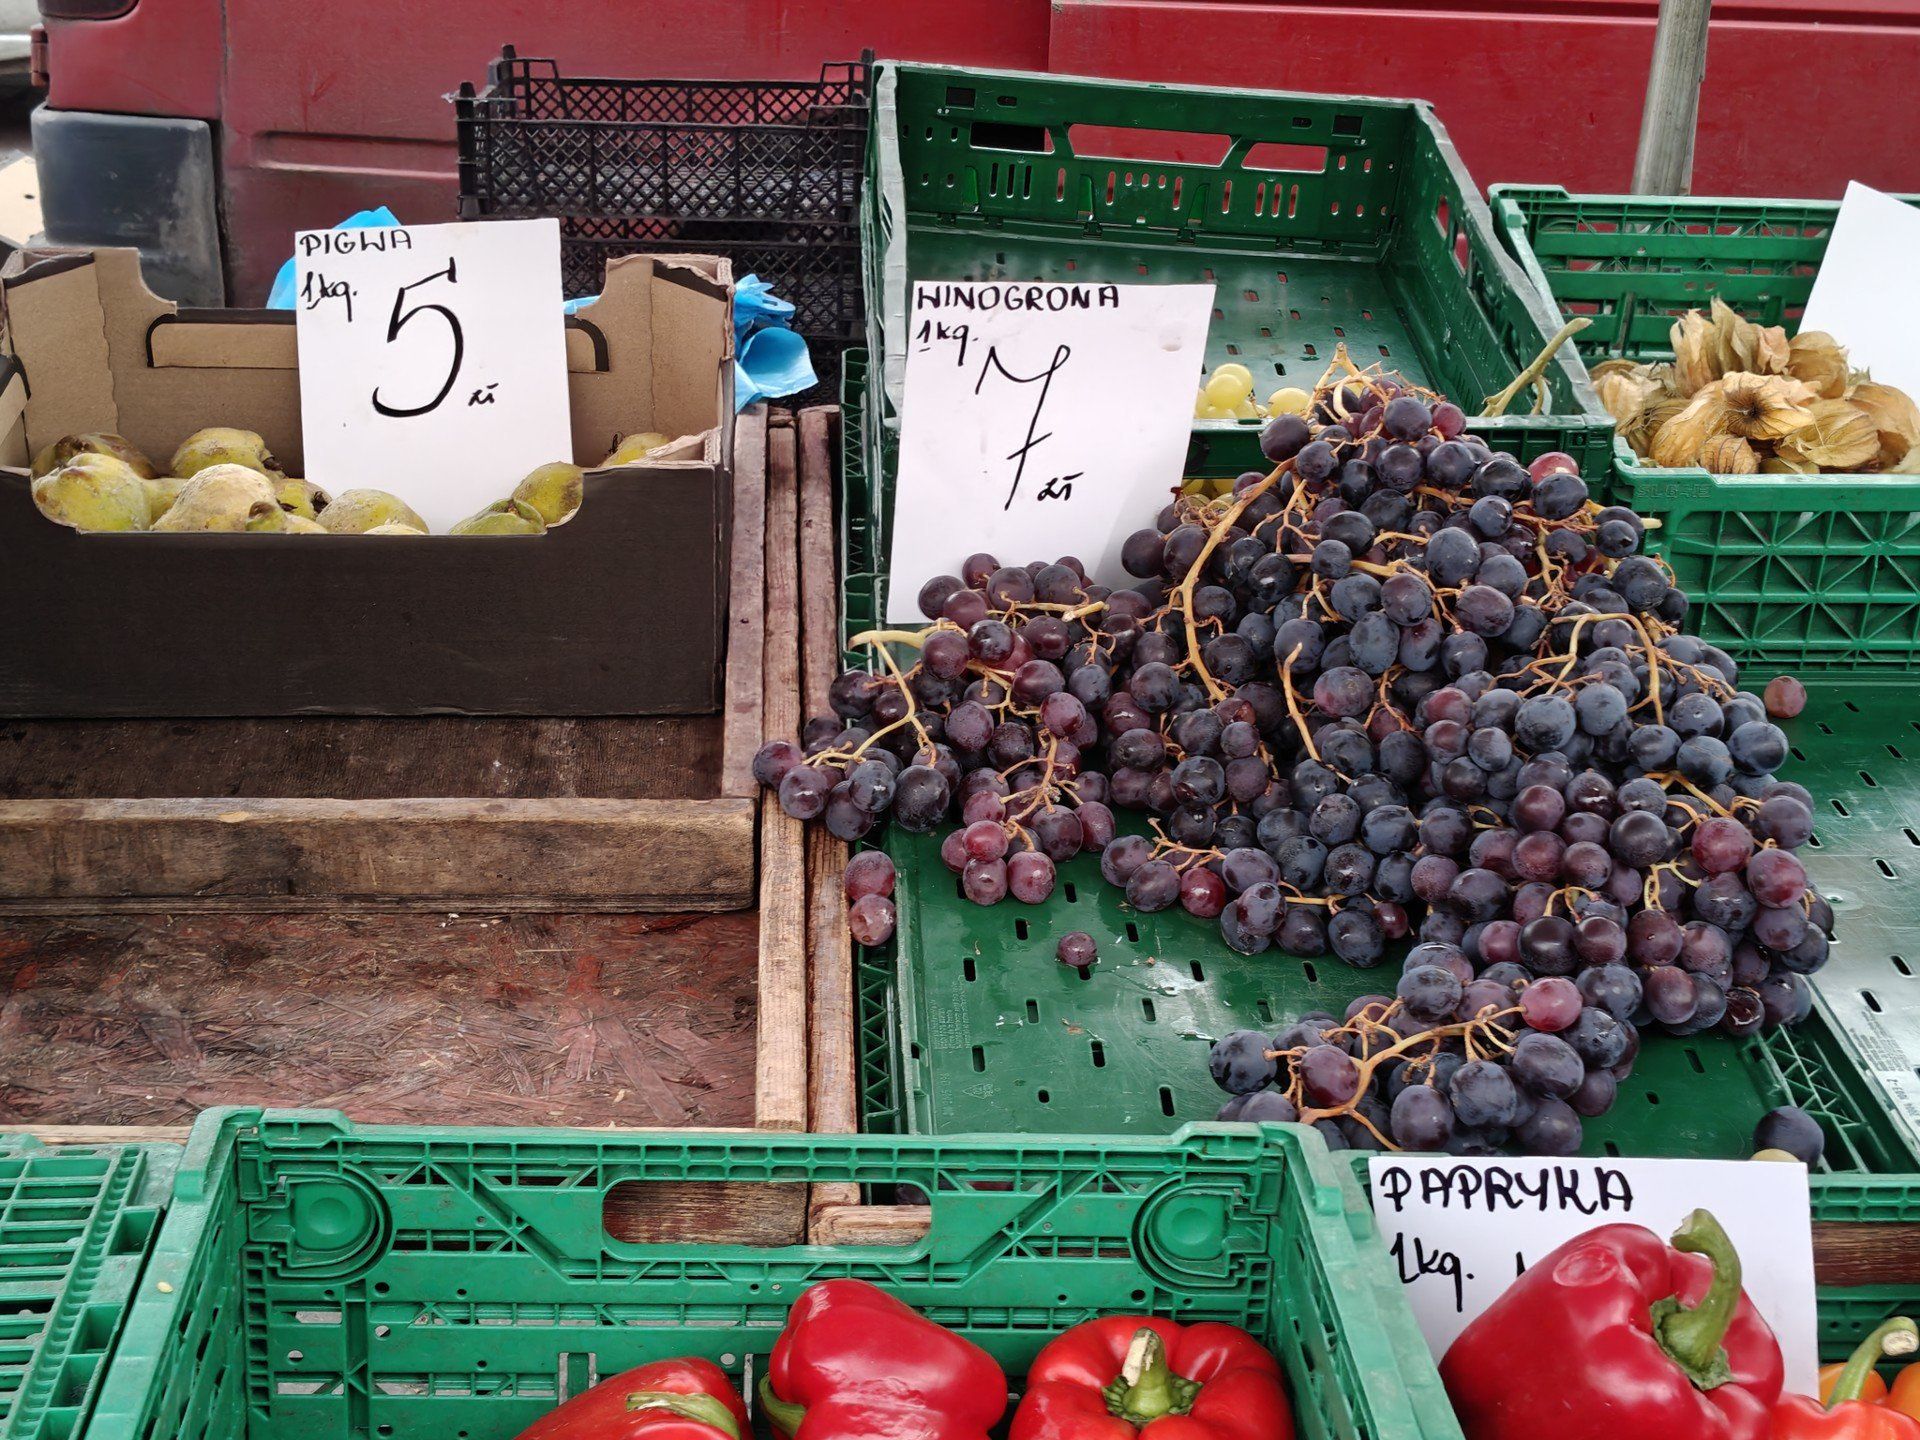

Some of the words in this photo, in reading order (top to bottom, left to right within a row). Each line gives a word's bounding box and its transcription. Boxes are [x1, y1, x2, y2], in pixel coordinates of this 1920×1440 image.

[298, 228, 412, 257] PIGWA
[917, 284, 1120, 312] WINOGRONA
[372, 256, 464, 418] 5
[975, 344, 1072, 511] 7
[1379, 1165, 1634, 1216] PAPRYKA
